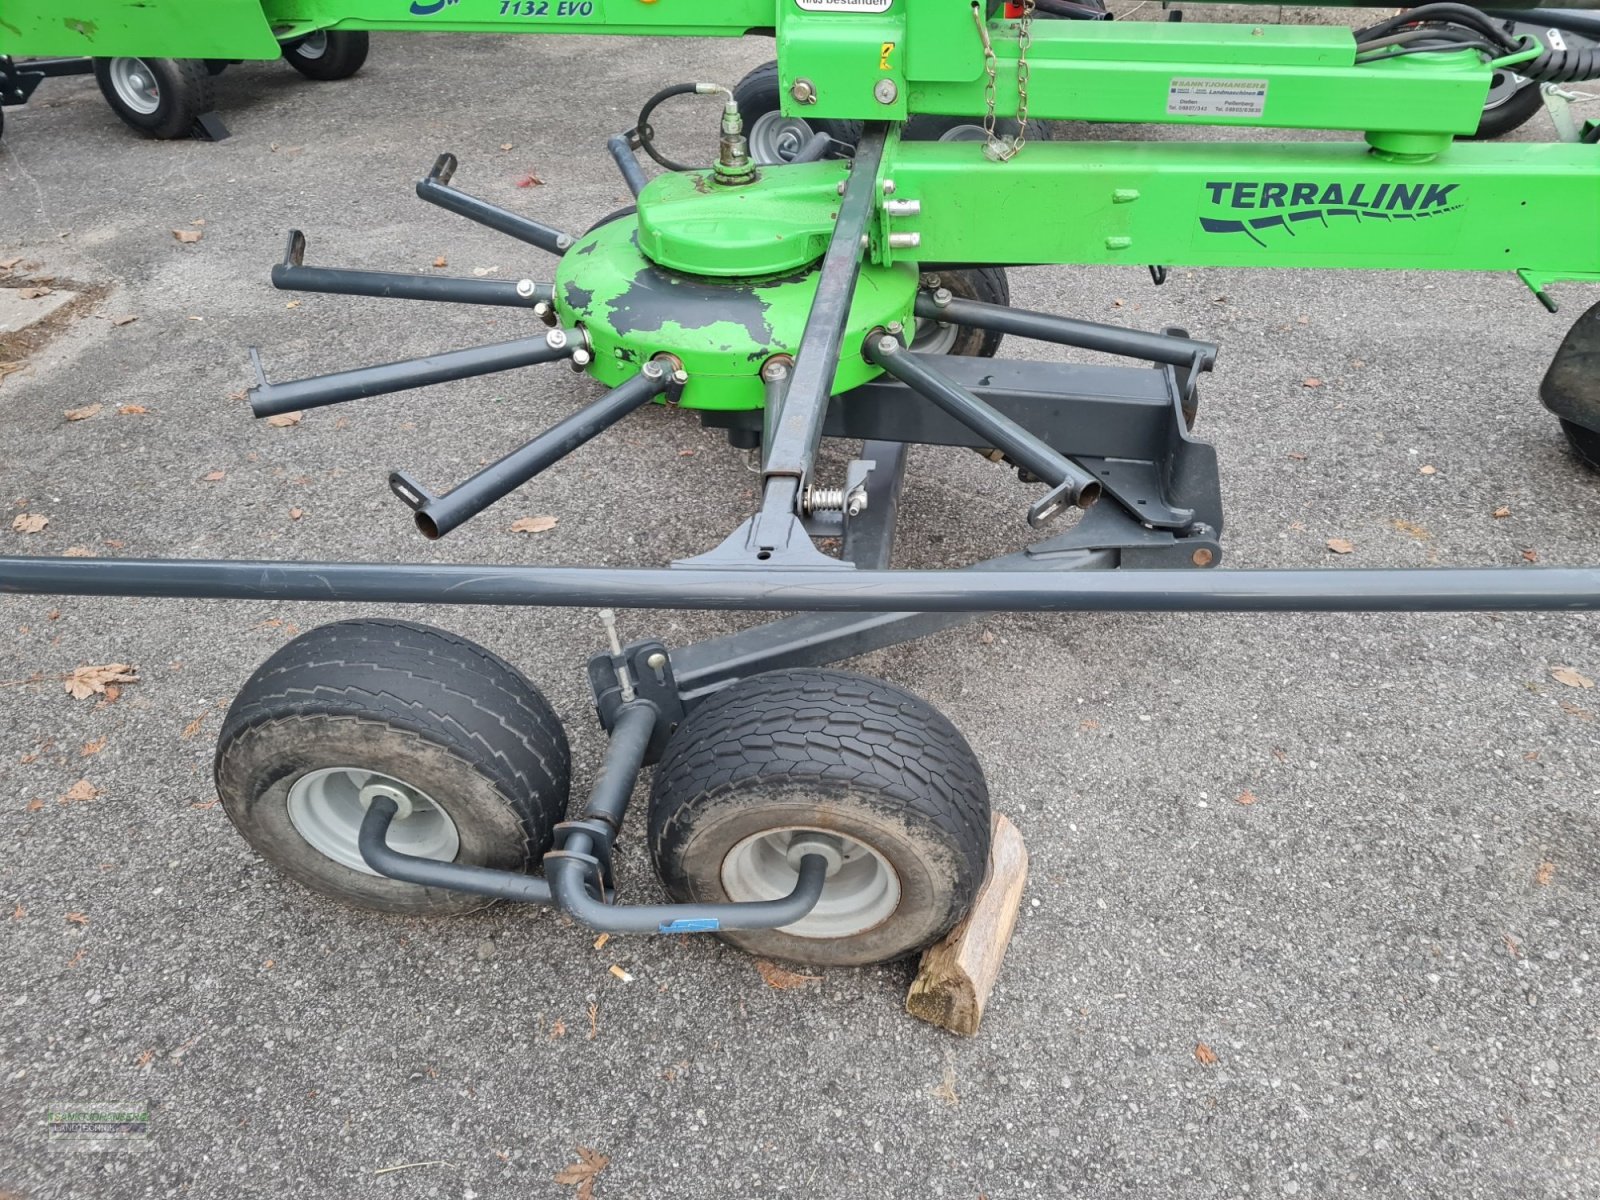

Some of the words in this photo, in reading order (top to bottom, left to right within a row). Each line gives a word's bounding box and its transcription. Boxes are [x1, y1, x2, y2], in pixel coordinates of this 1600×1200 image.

[500, 0, 549, 16] 7132
[557, 1, 592, 16] EVO
[1205, 182, 1460, 210] TERRALINK
